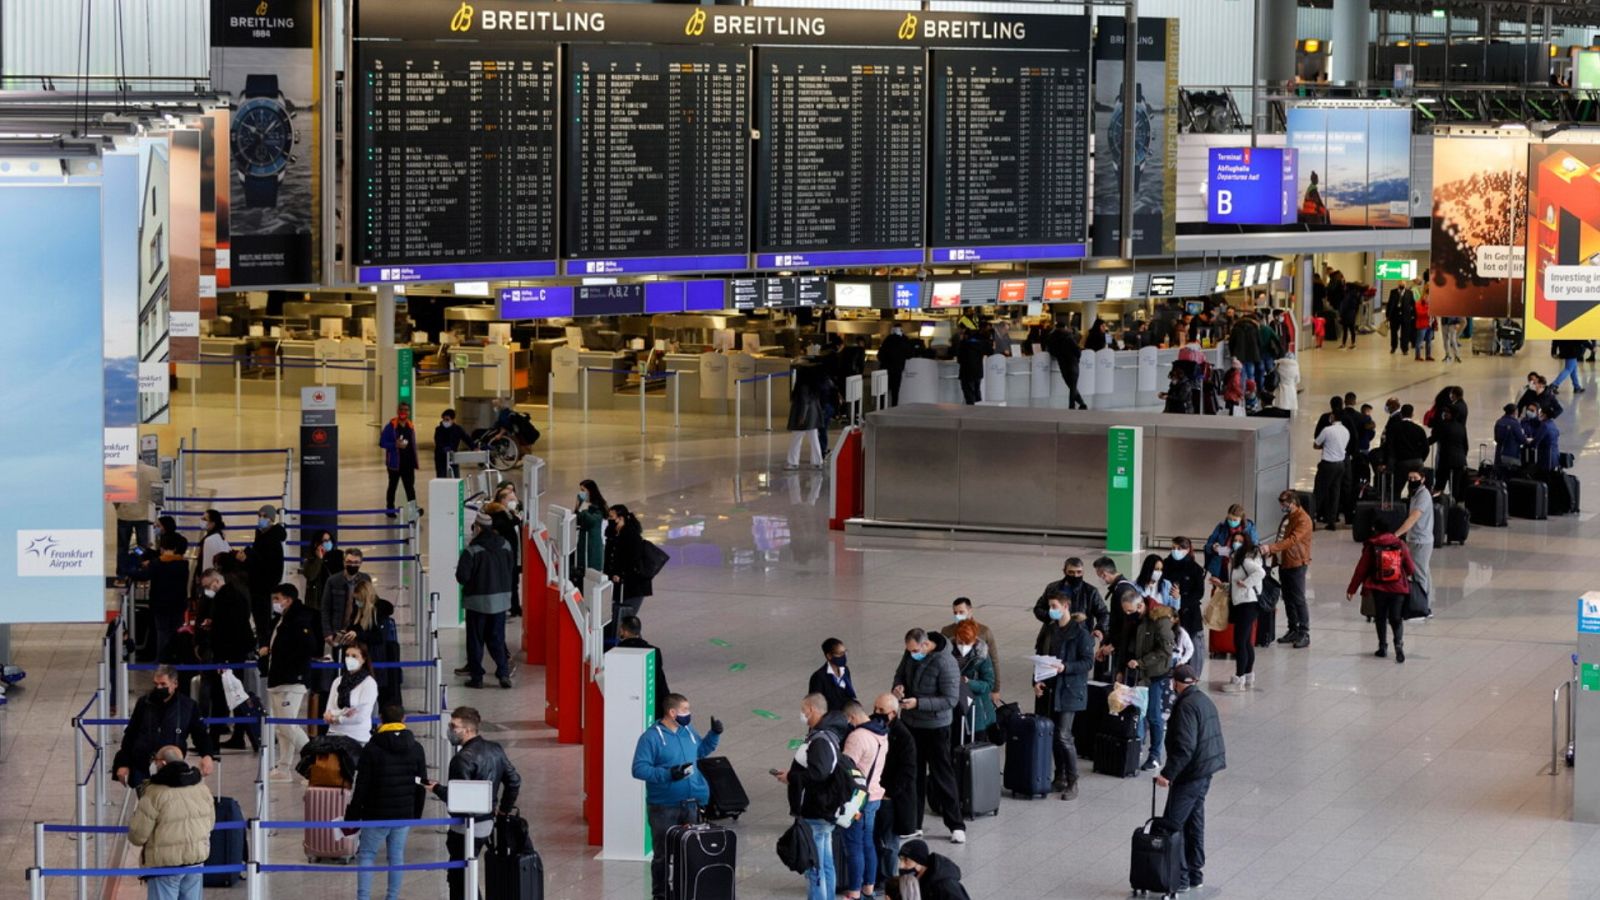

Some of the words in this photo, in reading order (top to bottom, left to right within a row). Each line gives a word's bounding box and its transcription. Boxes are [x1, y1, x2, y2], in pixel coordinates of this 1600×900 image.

[230, 17, 294, 28] BREITLING
[482, 10, 605, 31] BREITLING
[714, 16, 825, 35] BREITLING
[924, 21, 1026, 40] BREITLING
[1218, 190, 1232, 214] B
[1551, 273, 1591, 282] Investing
[540, 289, 546, 300] C
[608, 286, 628, 298] A,B,Z
[1551, 285, 1563, 293] for
[51, 550, 93, 558] Frankfurt
[49, 559, 82, 570] Airport
